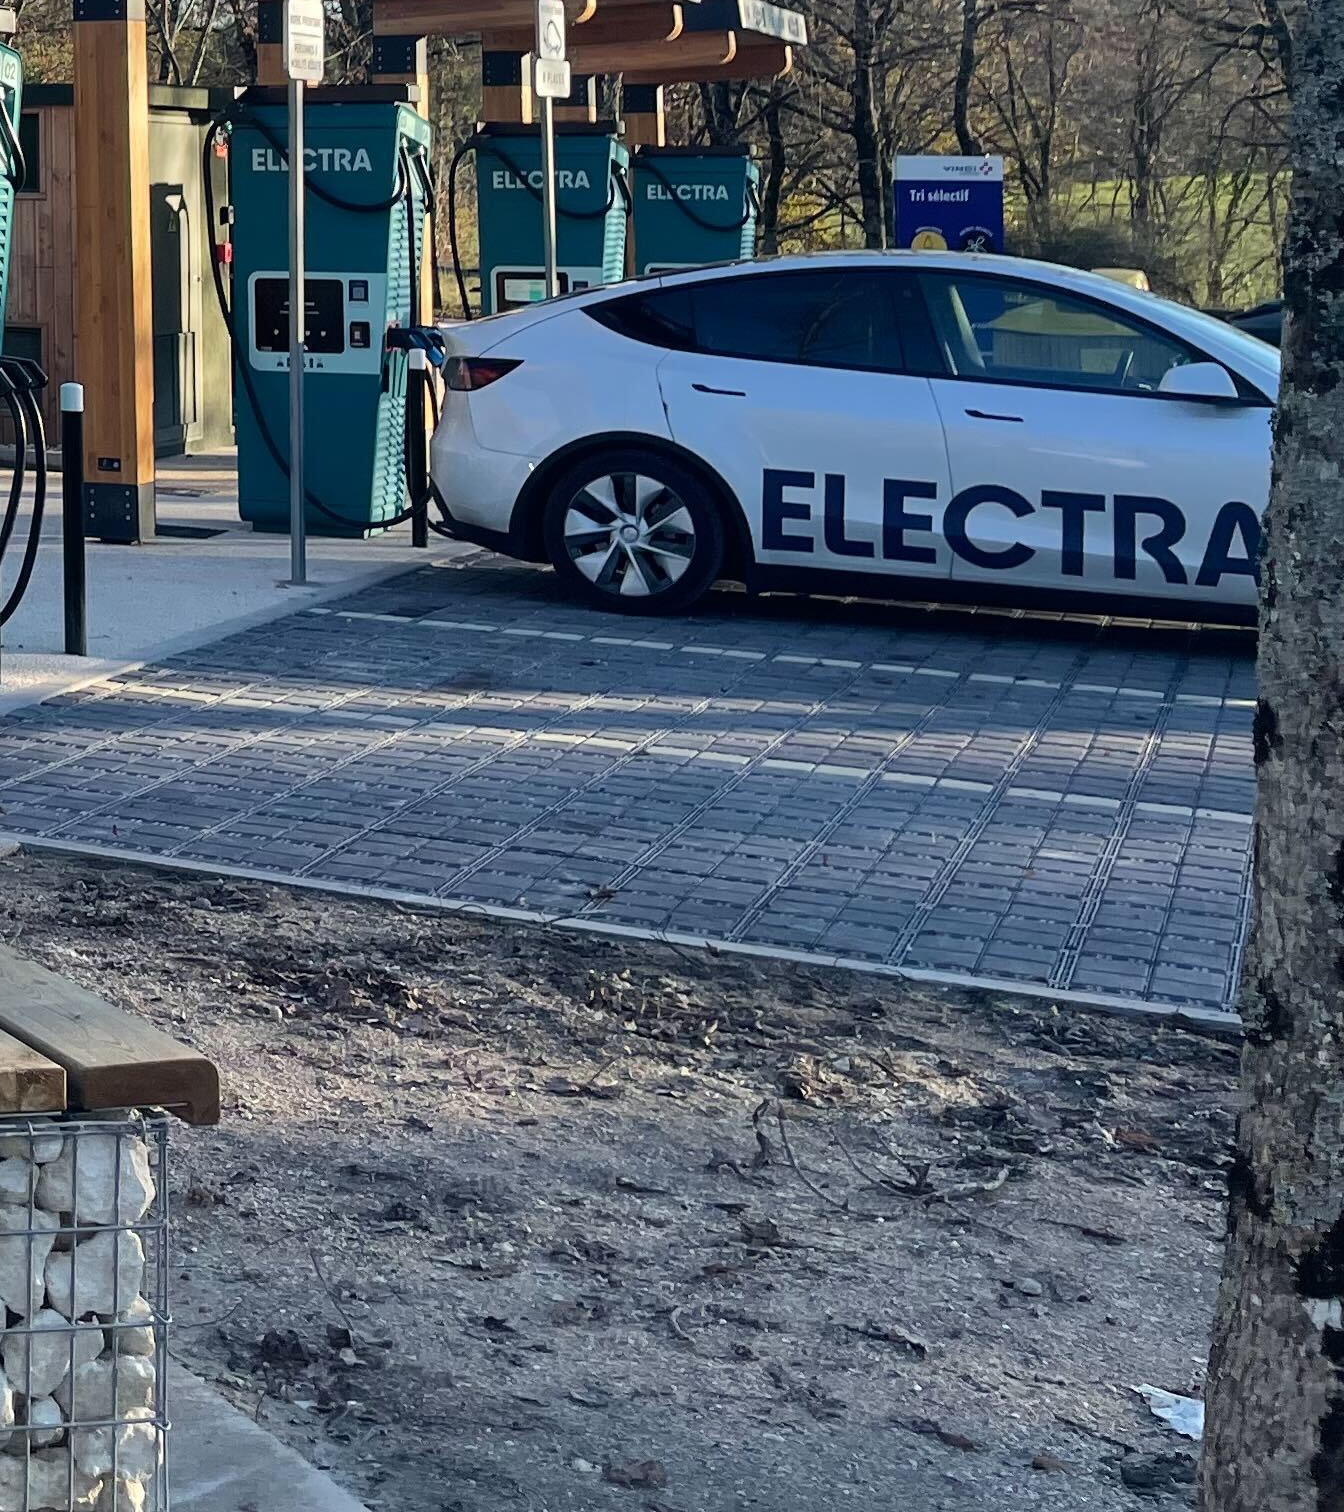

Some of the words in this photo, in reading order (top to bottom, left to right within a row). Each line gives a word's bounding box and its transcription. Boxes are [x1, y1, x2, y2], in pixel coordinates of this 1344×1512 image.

[4, 62, 16, 80] 02
[251, 148, 373, 172] ELCTRA
[492, 170, 591, 189] ELCRA
[908, 188, 925, 202] Tri
[761, 468, 1262, 587] ELECTRA
